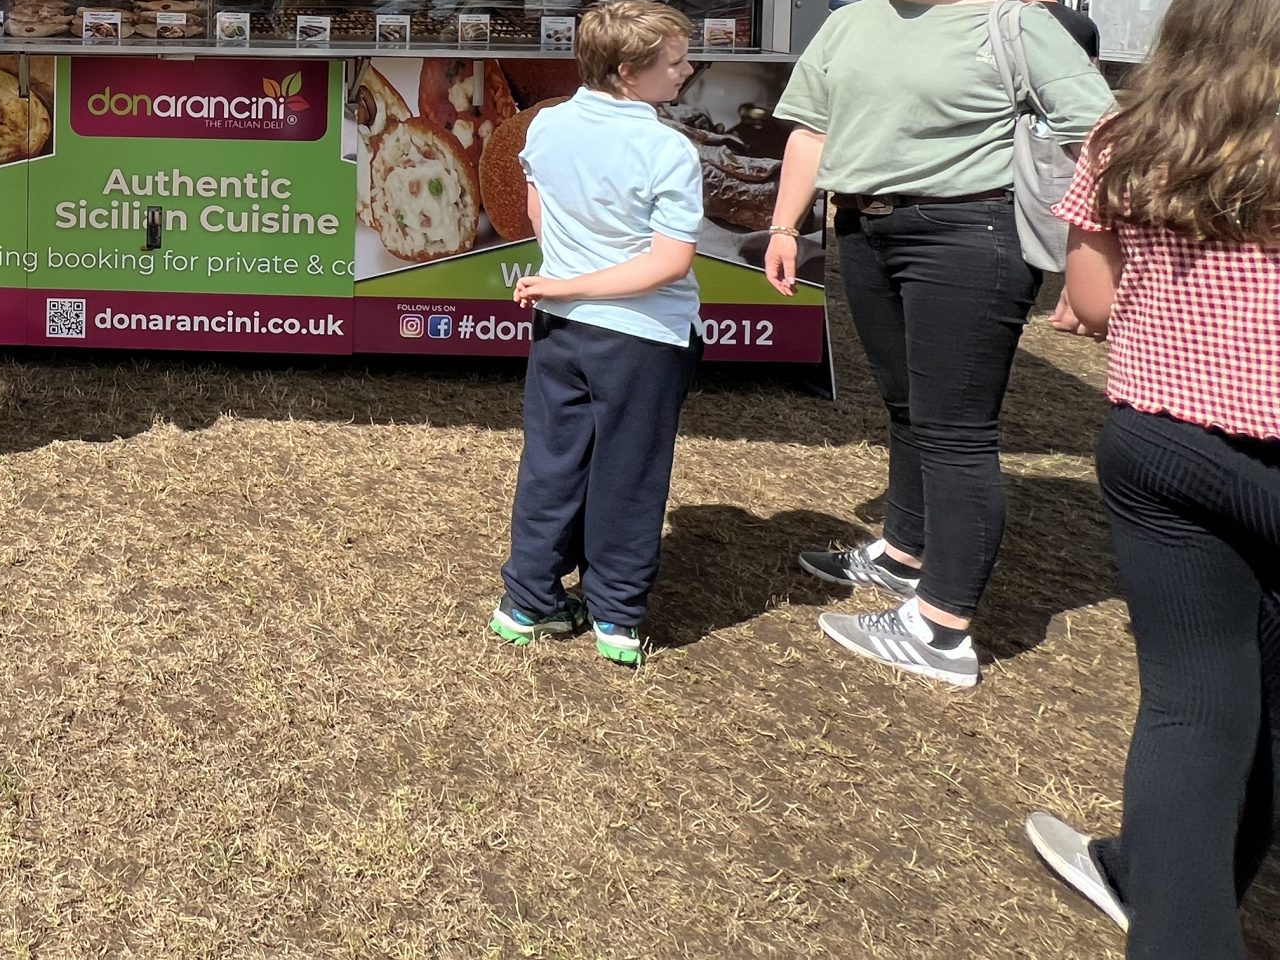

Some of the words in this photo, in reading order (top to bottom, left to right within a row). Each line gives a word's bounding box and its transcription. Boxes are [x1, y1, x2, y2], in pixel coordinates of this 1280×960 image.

[87, 86, 285, 119] donarancini
[204, 119, 223, 128] THE
[224, 120, 261, 129] ITALIAN
[262, 121, 284, 130] DELI
[102, 168, 292, 199] Authentic
[55, 200, 188, 232] Sicilin
[200, 203, 340, 235] Cuisine
[47, 247, 155, 275] booking
[162, 249, 199, 272] for
[207, 250, 299, 277] private
[306, 254, 325, 275] &
[94, 308, 345, 336] donarancini.co.uk
[396, 303, 431, 311] FOLLOW
[443, 304, 456, 312] ON
